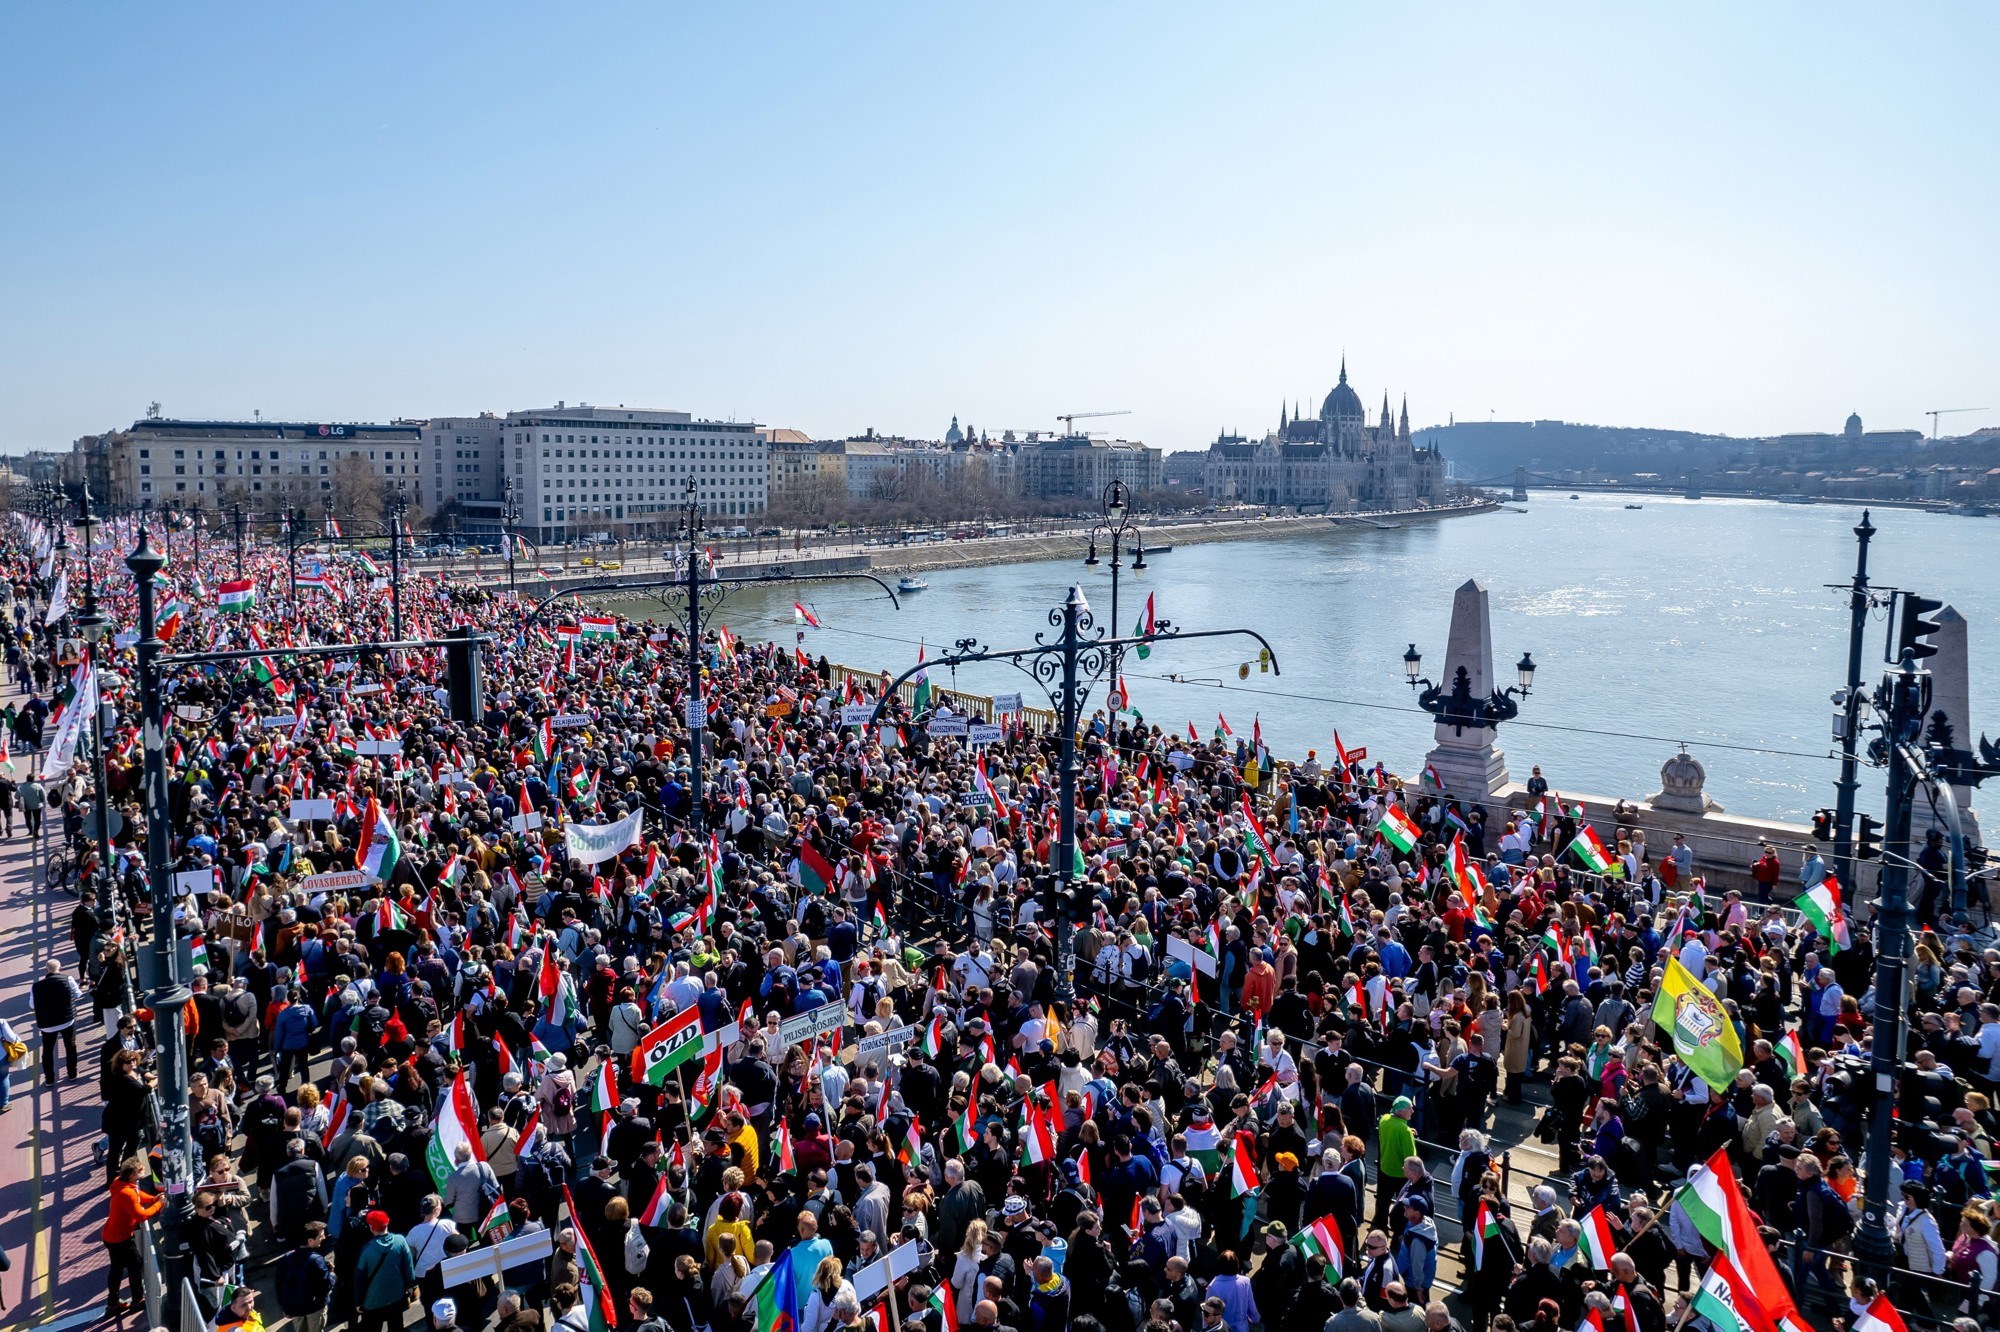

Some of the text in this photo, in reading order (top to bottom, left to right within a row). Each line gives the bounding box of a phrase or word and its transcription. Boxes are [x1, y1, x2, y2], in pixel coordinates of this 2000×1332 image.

[331, 426, 344, 435] LG
[552, 717, 586, 726] TELKIBÁNYA
[973, 732, 1000, 741] SASHALOM
[1348, 750, 1364, 760] EGER
[302, 872, 365, 890] LOVASBERÉNY
[783, 1011, 845, 1043] PILISBOROSJENŐ
[650, 1024, 698, 1063] ÓZD
